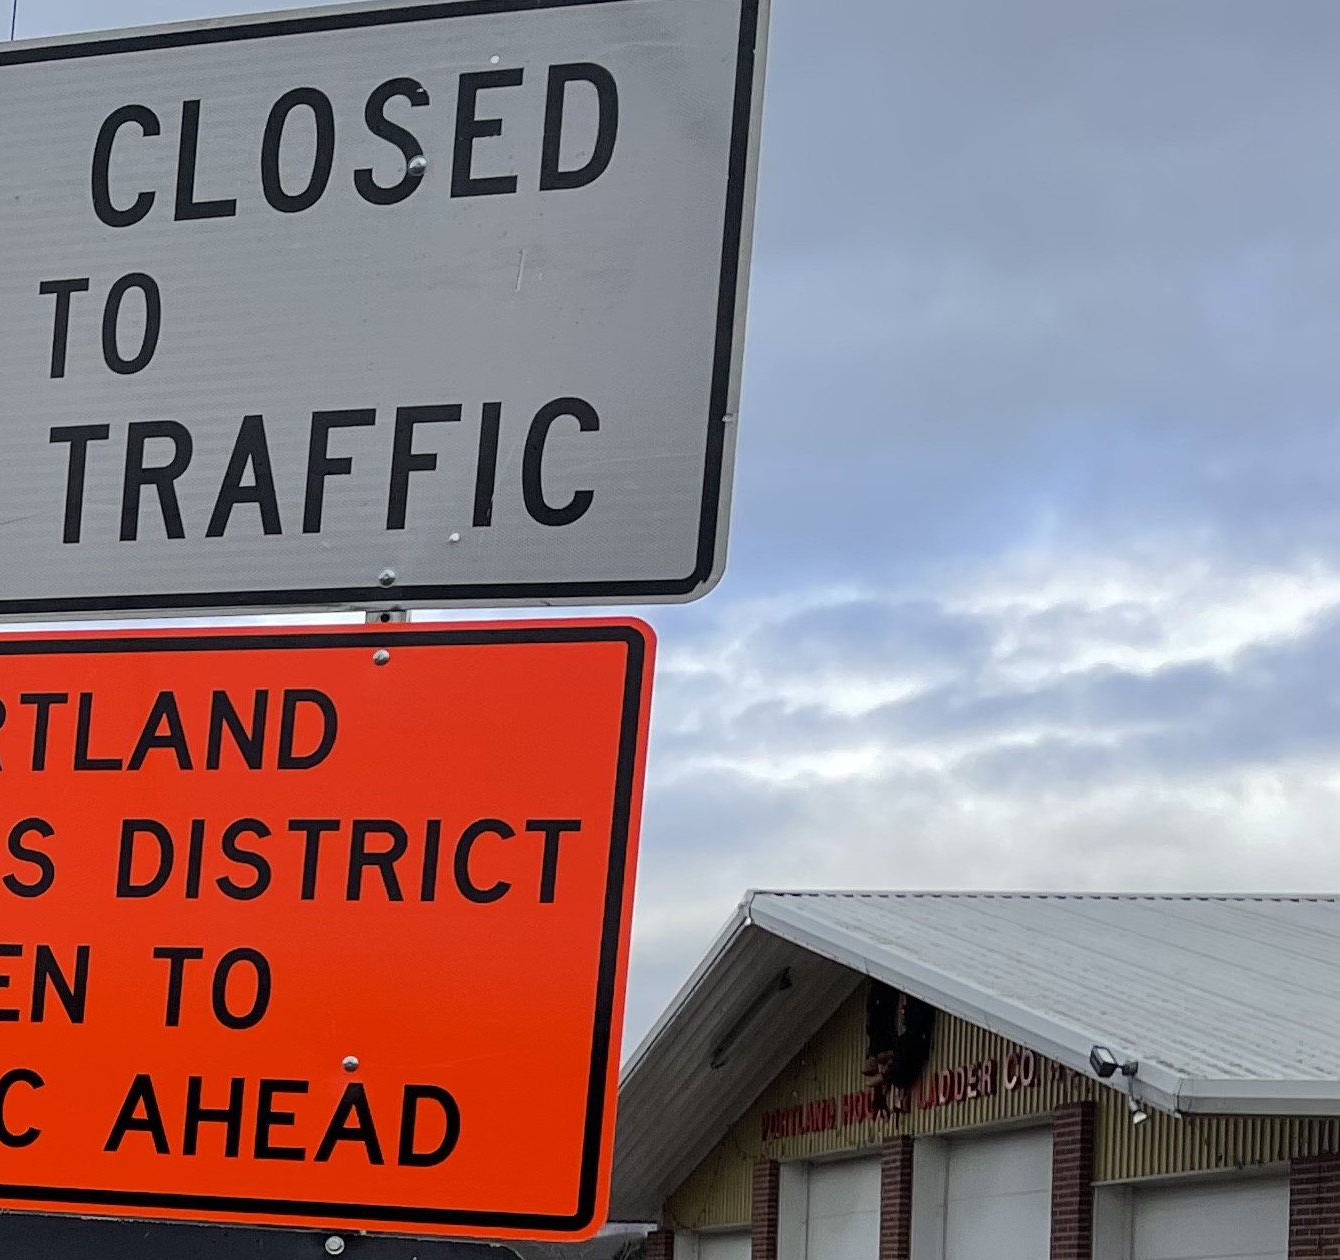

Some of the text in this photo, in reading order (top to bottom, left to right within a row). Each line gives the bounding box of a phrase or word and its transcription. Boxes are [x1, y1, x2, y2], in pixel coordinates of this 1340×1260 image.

[92, 62, 619, 227] CLOSED
[39, 272, 161, 379] TO
[50, 397, 601, 544] TRAFFIC
[115, 817, 581, 904] DISTRICT
[153, 947, 272, 1030] TO
[104, 1072, 462, 1168] AHEAD
